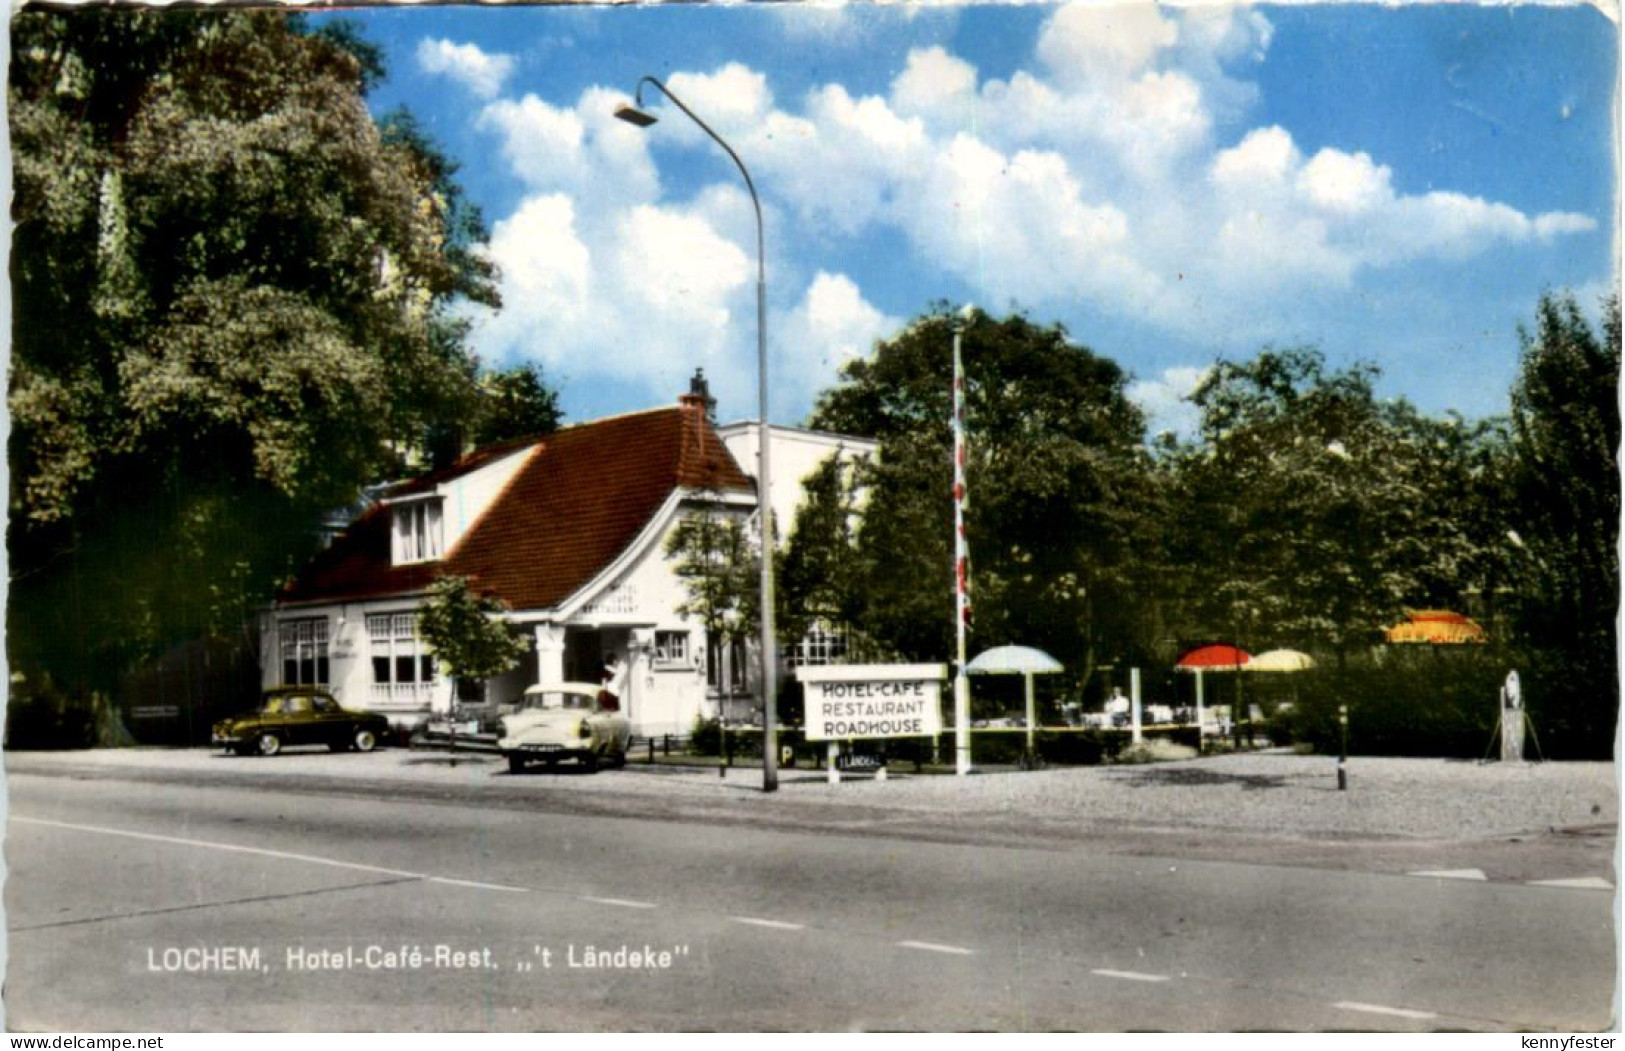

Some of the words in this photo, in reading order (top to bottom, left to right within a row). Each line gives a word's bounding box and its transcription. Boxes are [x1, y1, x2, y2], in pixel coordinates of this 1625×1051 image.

[822, 701, 925, 716] RESTAURANT
[824, 719, 922, 736] ROADHOUSE
[782, 745, 793, 764] P
